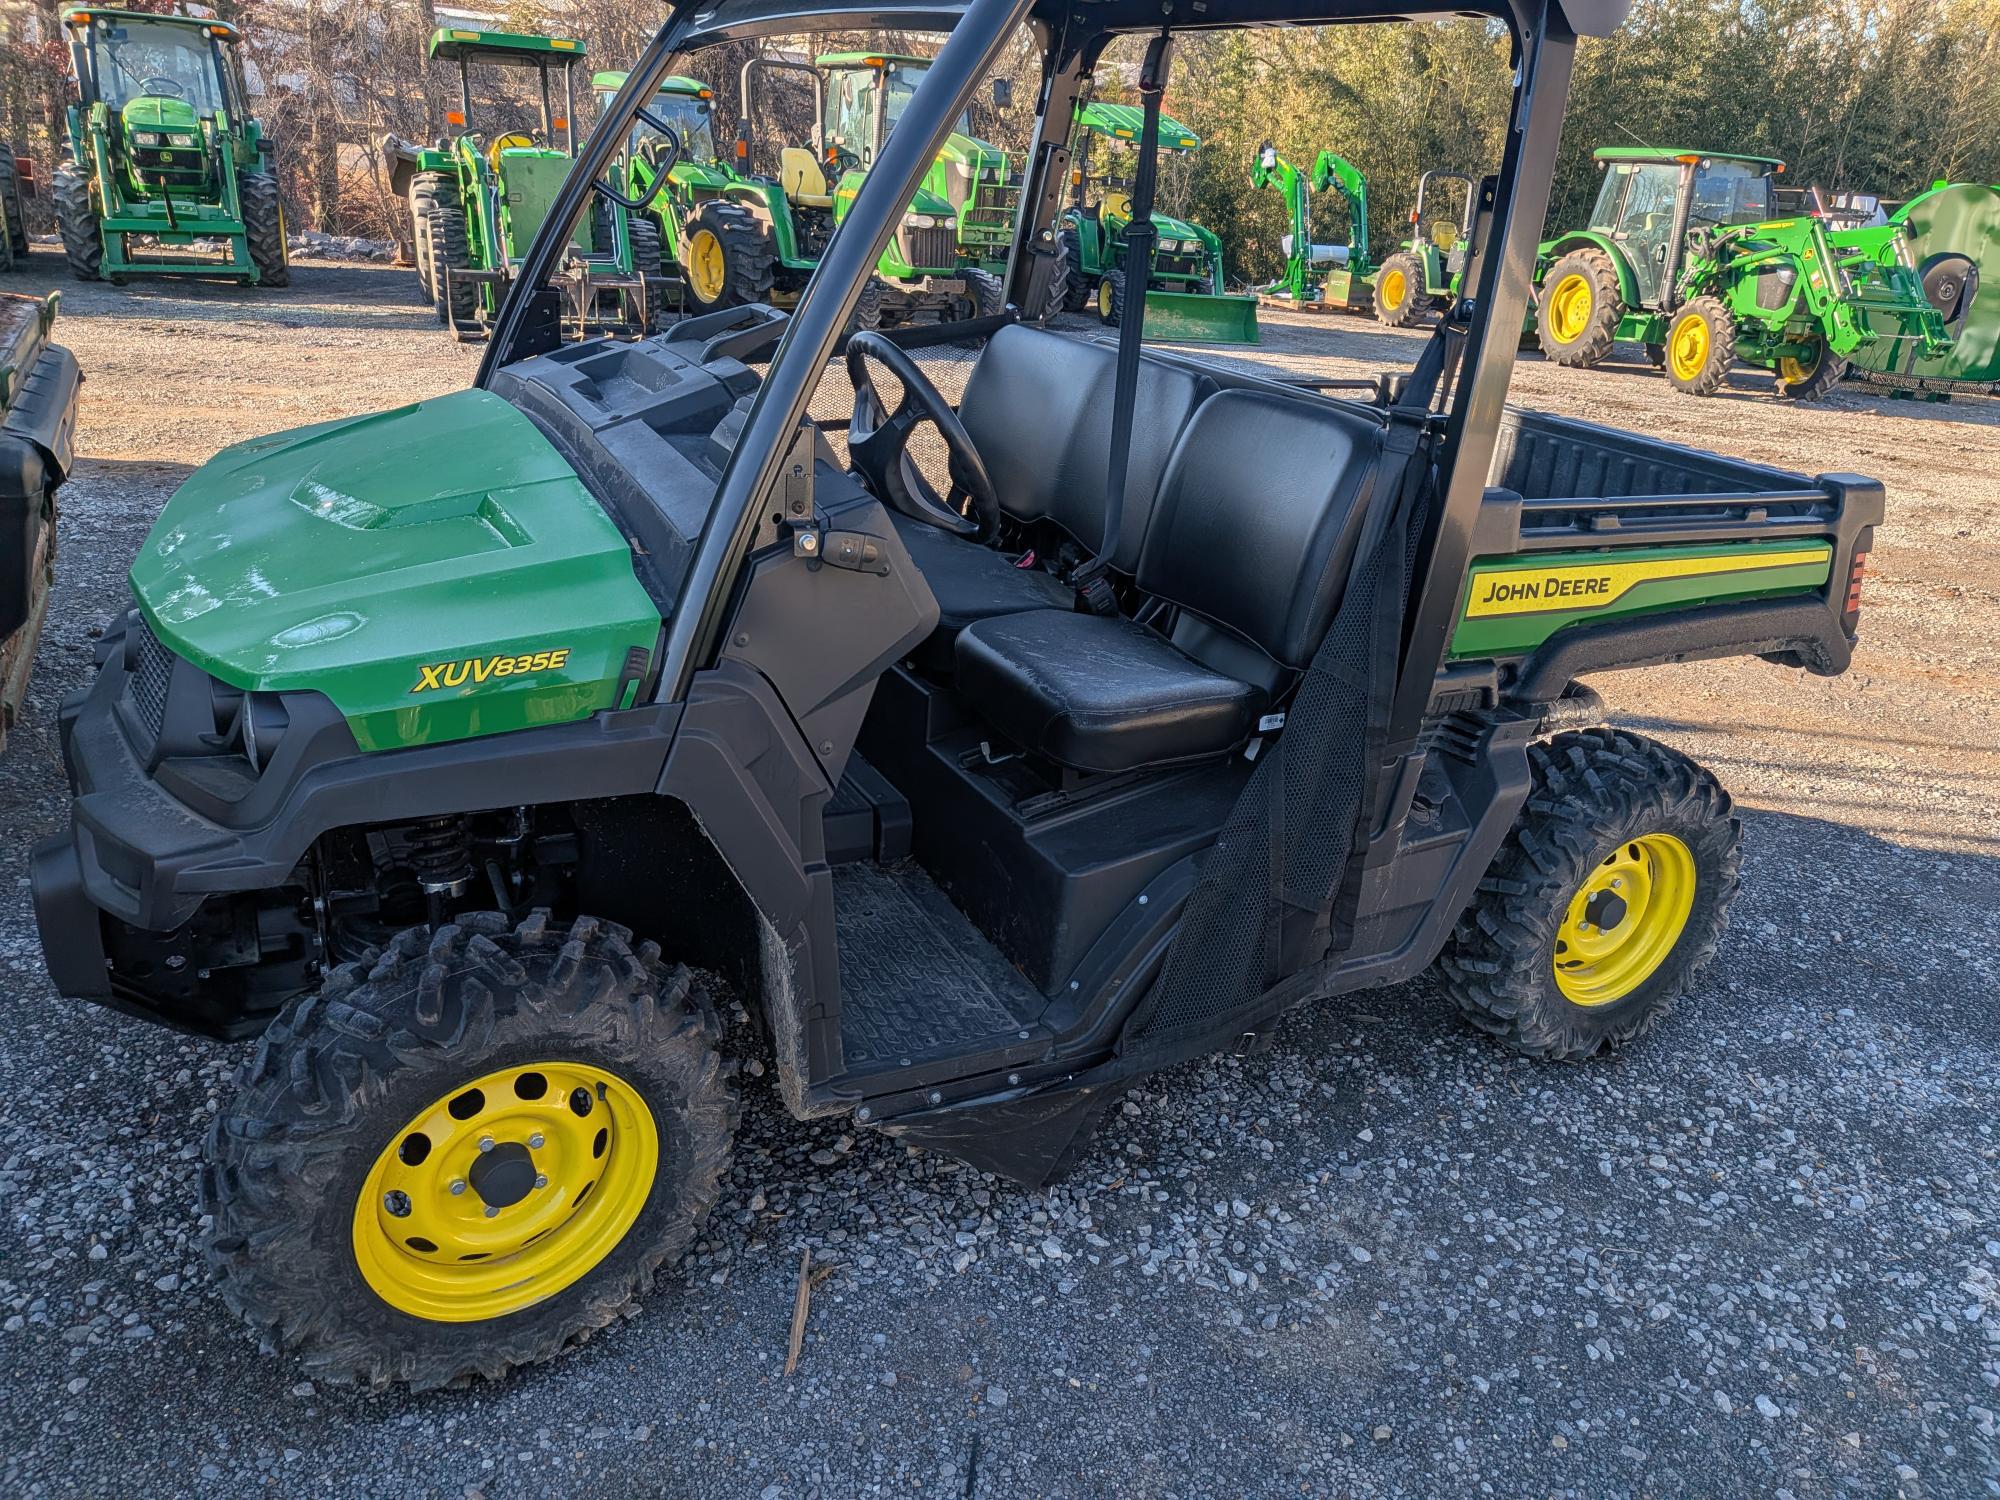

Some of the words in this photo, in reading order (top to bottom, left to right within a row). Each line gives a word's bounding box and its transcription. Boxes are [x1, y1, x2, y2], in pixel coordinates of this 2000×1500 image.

[1482, 582, 1541, 603] JOHN
[1543, 577, 1612, 598] DEERE
[408, 647, 571, 693] XUV835E
